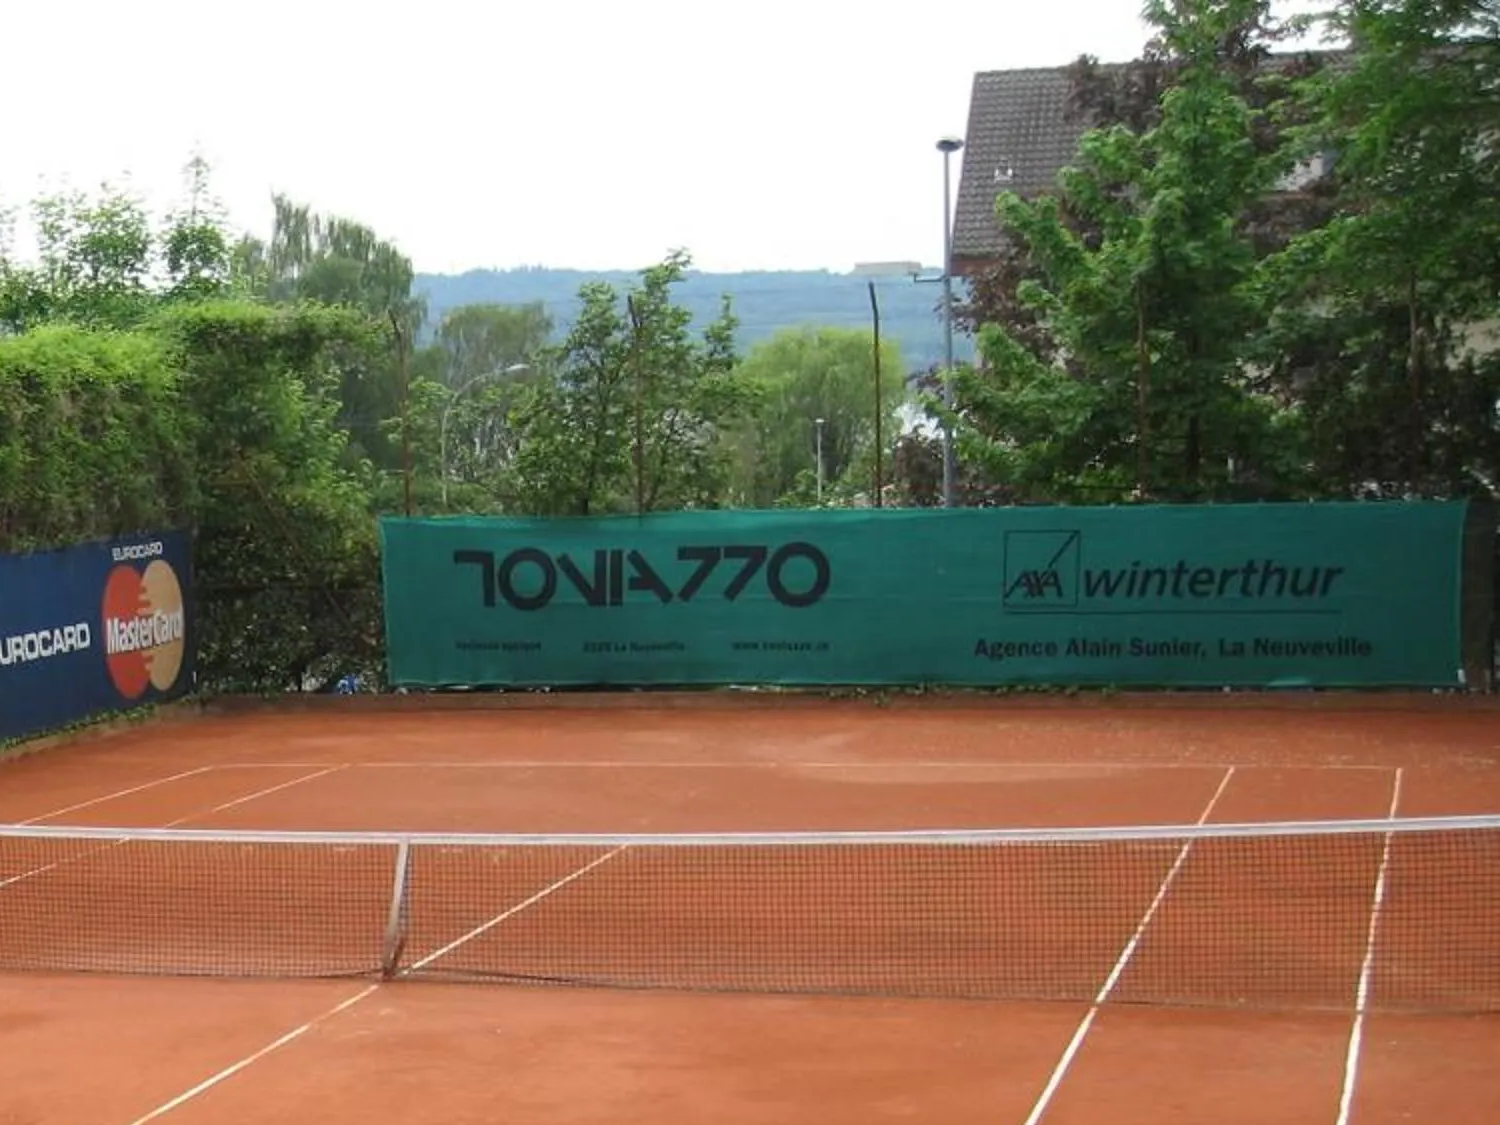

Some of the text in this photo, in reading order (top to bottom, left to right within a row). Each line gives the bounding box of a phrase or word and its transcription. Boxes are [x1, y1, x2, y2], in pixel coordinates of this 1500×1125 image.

[111, 541, 163, 561] EUROCARD
[1083, 558, 1345, 600] winterthur
[106, 606, 184, 655] MasterCard
[973, 637, 1058, 661] Agence
[1064, 637, 1122, 658] Alain
[1218, 637, 1245, 658] La
[1252, 637, 1374, 659] Neuveville
